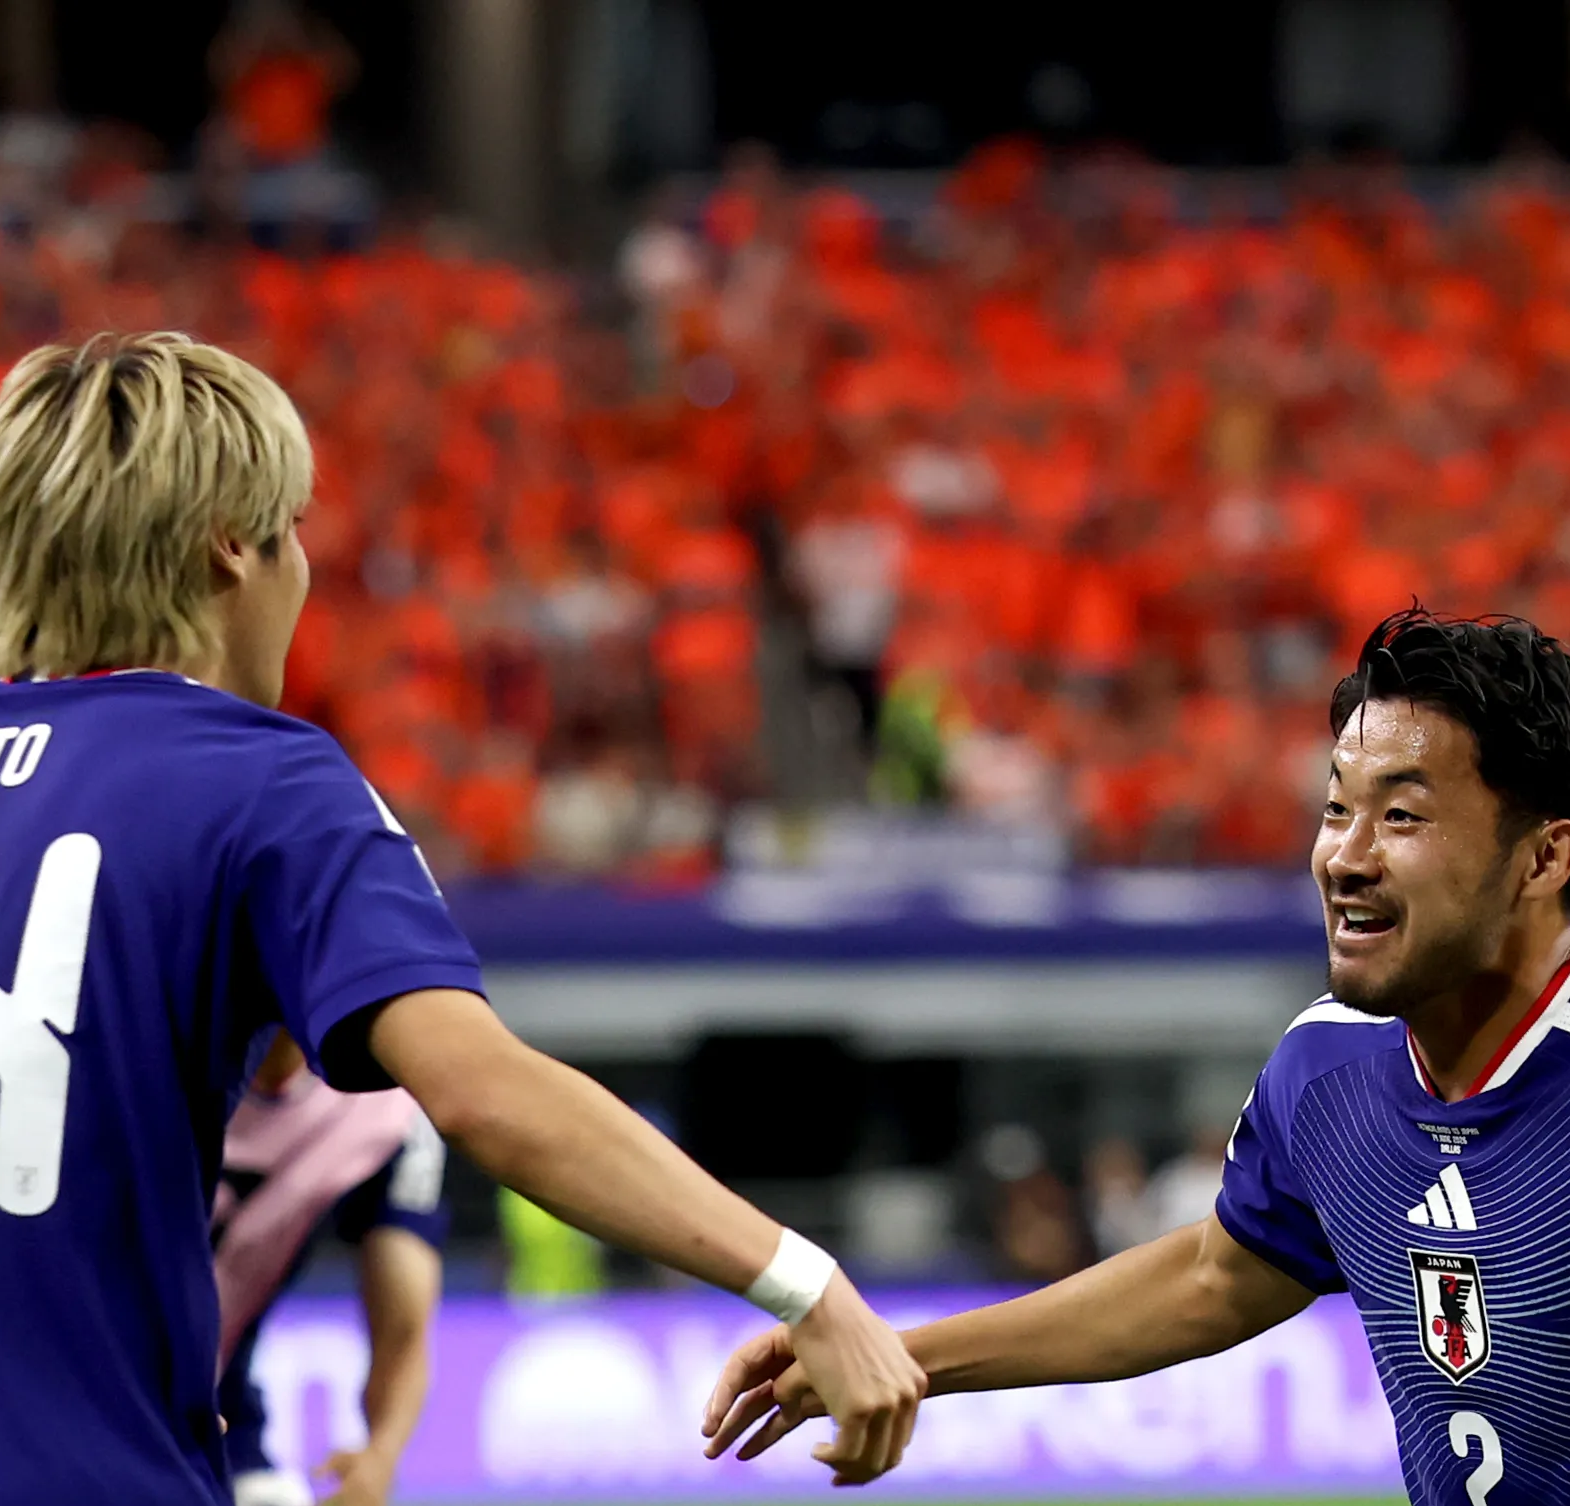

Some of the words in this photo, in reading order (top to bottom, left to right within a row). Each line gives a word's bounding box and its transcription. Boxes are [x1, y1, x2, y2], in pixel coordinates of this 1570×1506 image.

[1440, 1143, 1461, 1155] DALLAS
[1427, 1257, 1462, 1269] JAPAN
[1440, 1338, 1472, 1360] JFA
